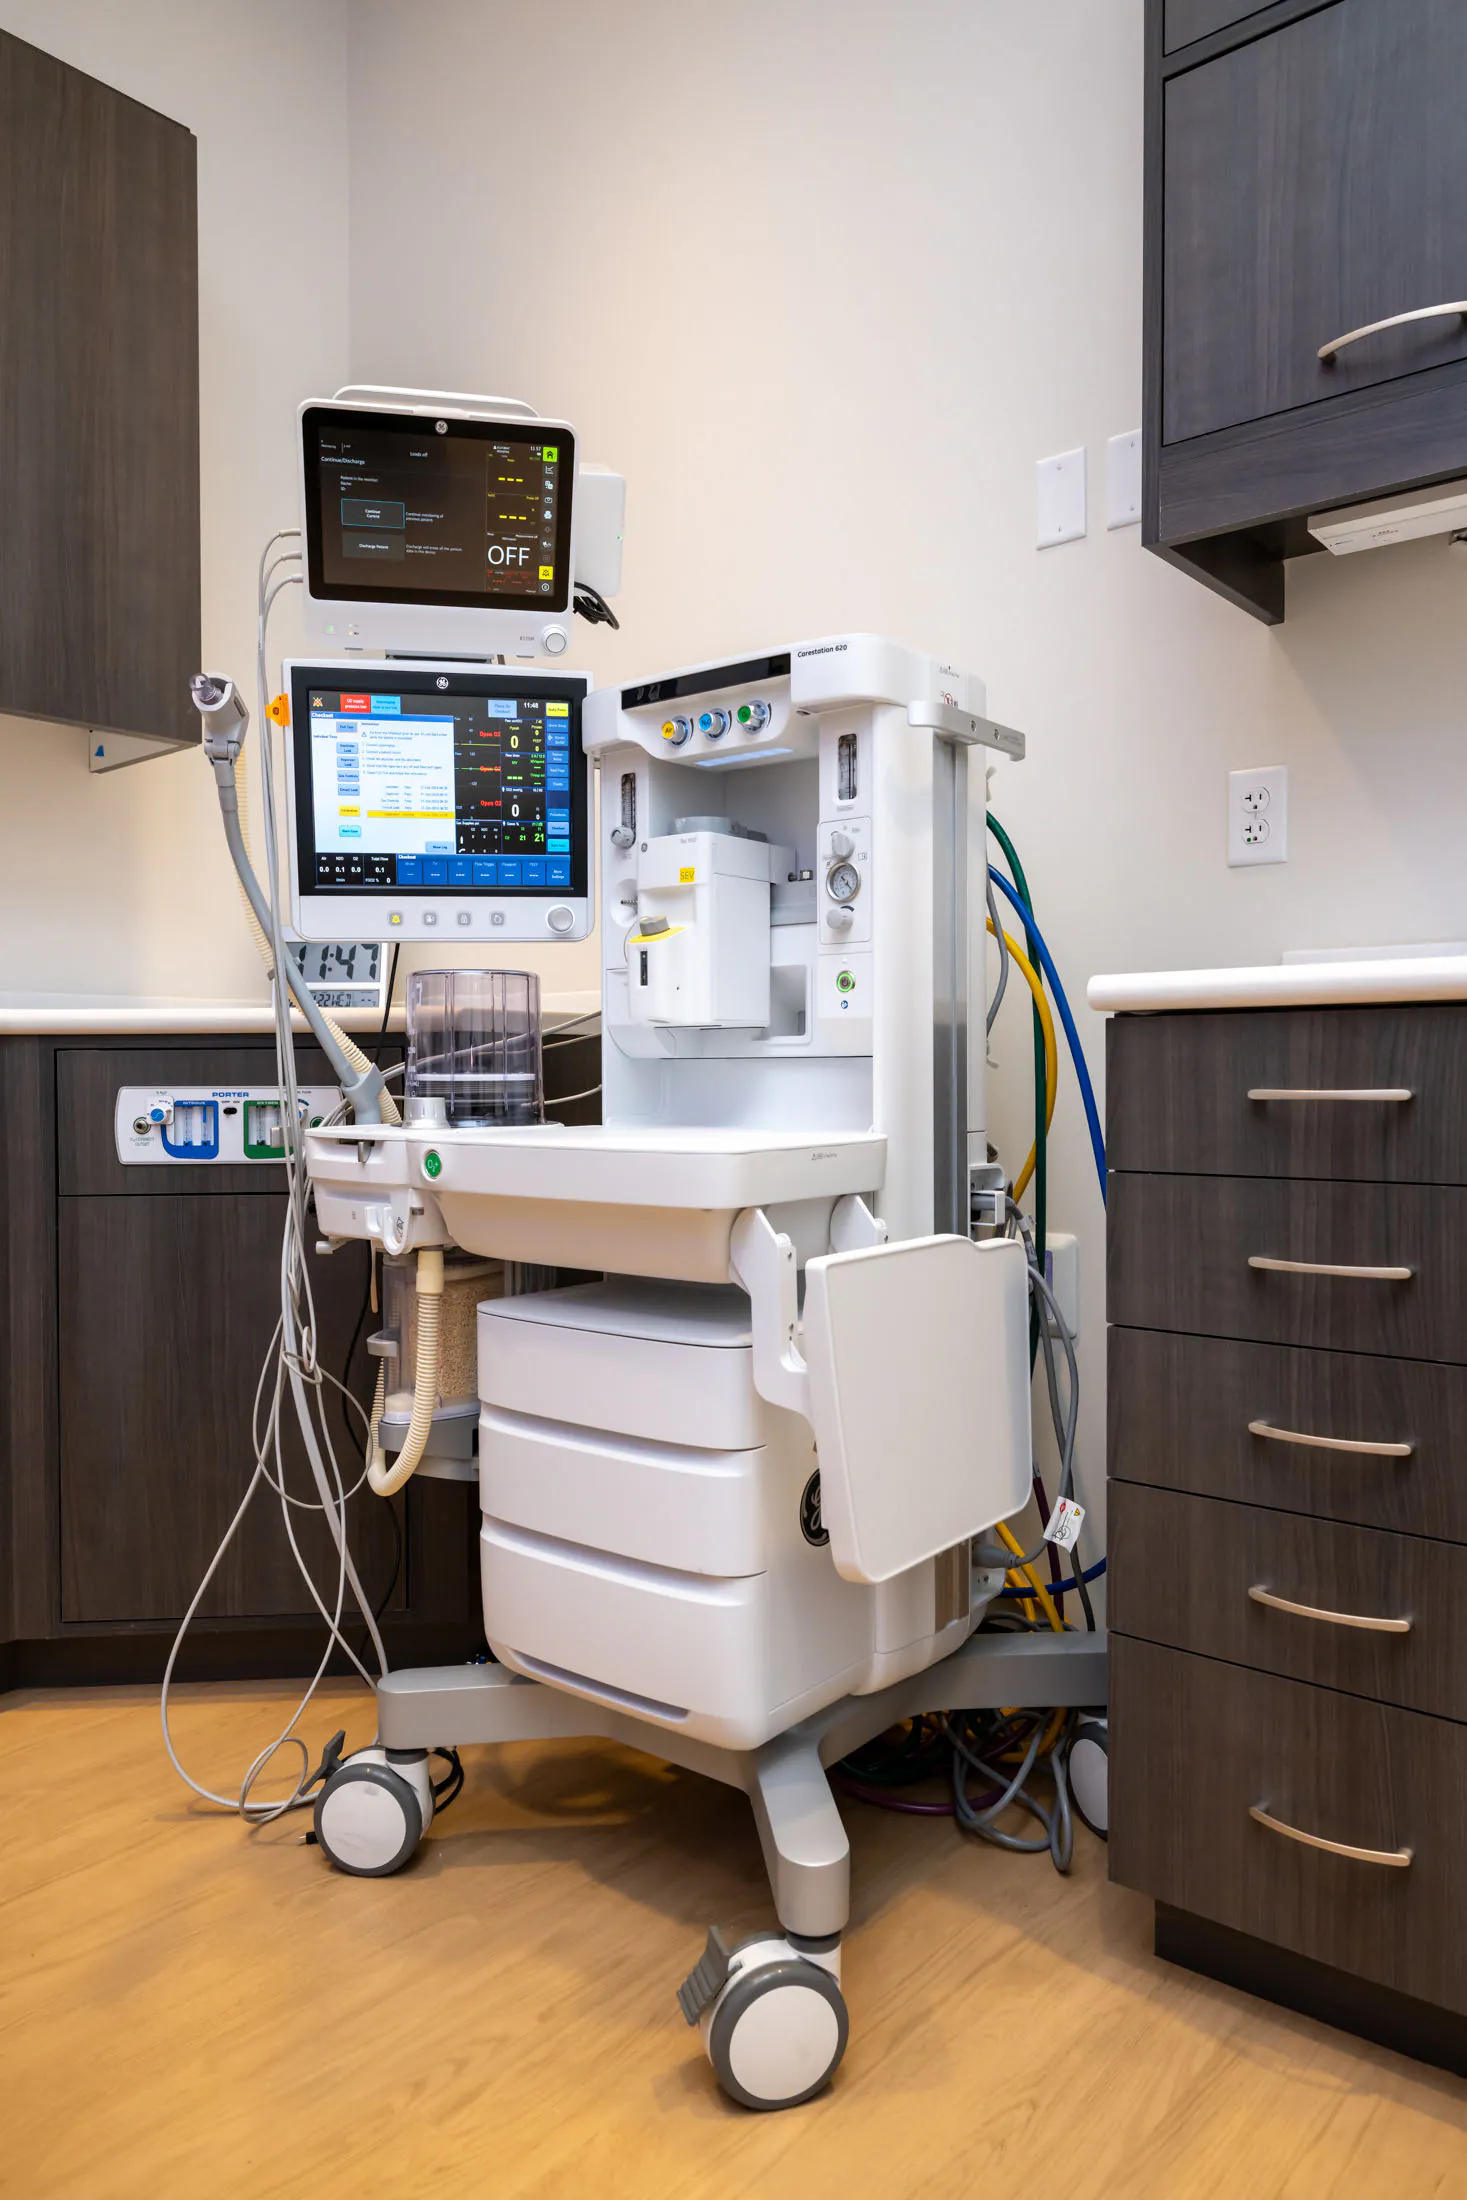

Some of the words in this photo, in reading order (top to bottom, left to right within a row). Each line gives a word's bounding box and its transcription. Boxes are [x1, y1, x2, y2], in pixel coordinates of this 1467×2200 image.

[488, 545, 530, 566] OFF
[797, 646, 834, 658] Carestation
[510, 735, 519, 749] 0
[511, 804, 520, 817] 0
[534, 833, 544, 842] 21
[680, 871, 695, 880] SEV
[298, 944, 379, 980] 11:47
